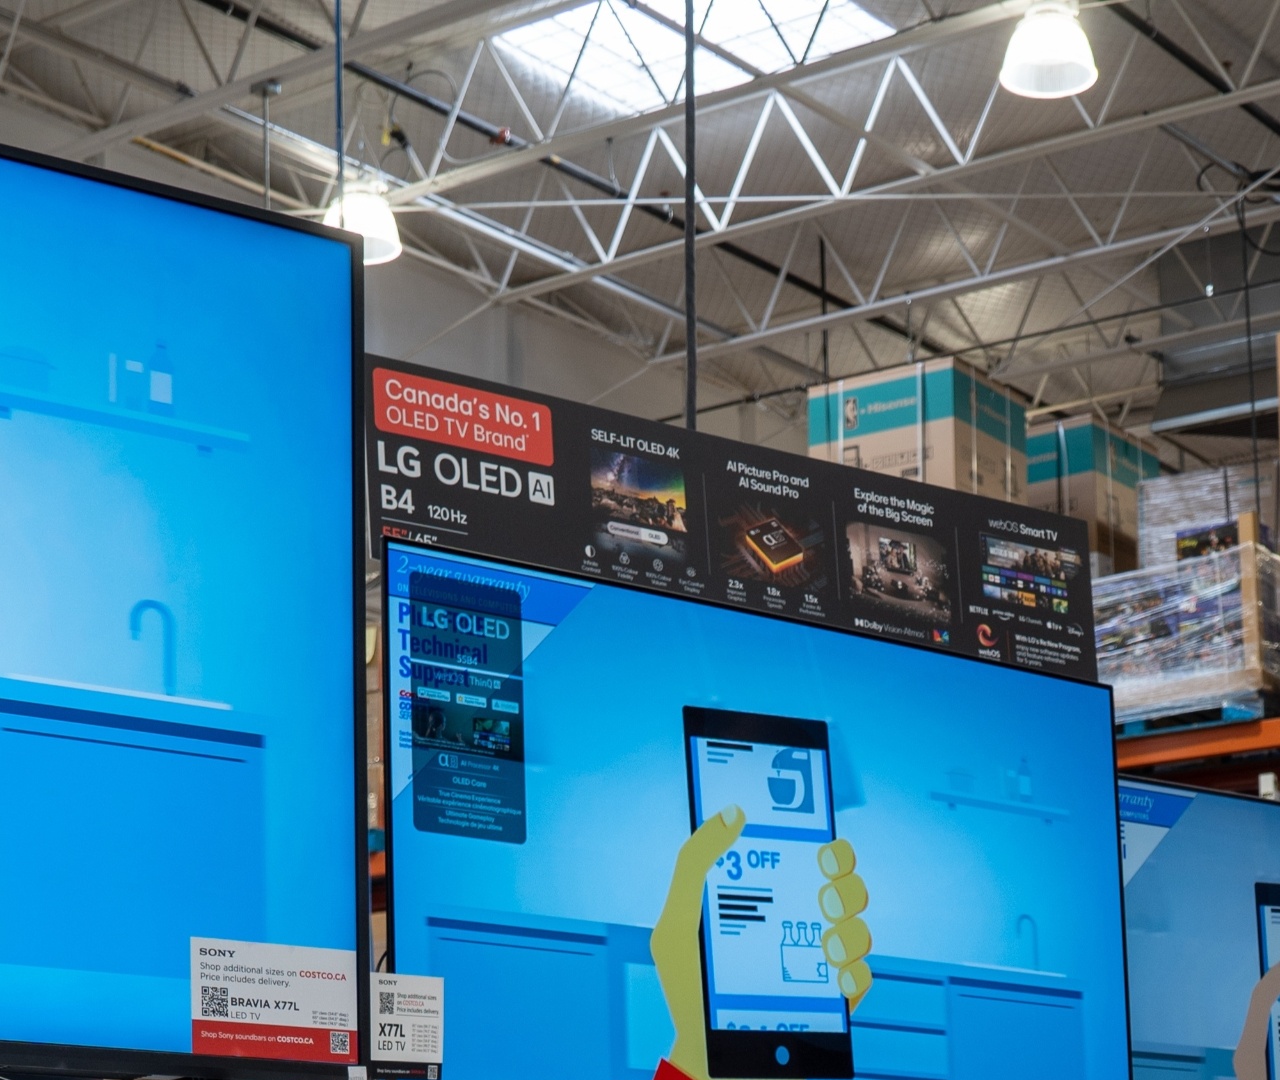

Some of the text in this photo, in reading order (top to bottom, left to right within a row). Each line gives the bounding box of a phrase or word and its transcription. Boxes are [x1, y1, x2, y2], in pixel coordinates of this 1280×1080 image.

[385, 379, 540, 431] Canada's No. 1
[386, 406, 526, 451] OLED TV Brand
[591, 428, 680, 460] SELF-LIT OLED 4K
[377, 440, 551, 499] LG OLED AI
[726, 460, 809, 488] AI Picture Pro and
[381, 484, 415, 514] B4
[739, 476, 799, 499] AI Sound Pro
[854, 488, 934, 515] Explore the Magic
[858, 503, 933, 527] of the Big Screen
[988, 519, 1058, 542] webOS Smart TV
[422, 606, 509, 639] LG OLED
[747, 850, 780, 870] OFF
[199, 948, 236, 958] SONY
[200, 962, 221, 972] Shop
[223, 963, 263, 974] additional
[265, 968, 284, 976] sizes
[299, 971, 347, 982] COSTCO.CA
[200, 973, 290, 988] Price includes delivery.
[231, 997, 299, 1011] BRAVIA X77L
[231, 1011, 261, 1021] LED TV
[201, 1030, 217, 1039] Shop
[219, 1032, 234, 1041] Sony
[235, 1033, 266, 1042] soundbars
[277, 1035, 314, 1044] COSTCO.CA
[378, 1023, 406, 1038] X77L
[377, 1041, 406, 1051] LED TV
